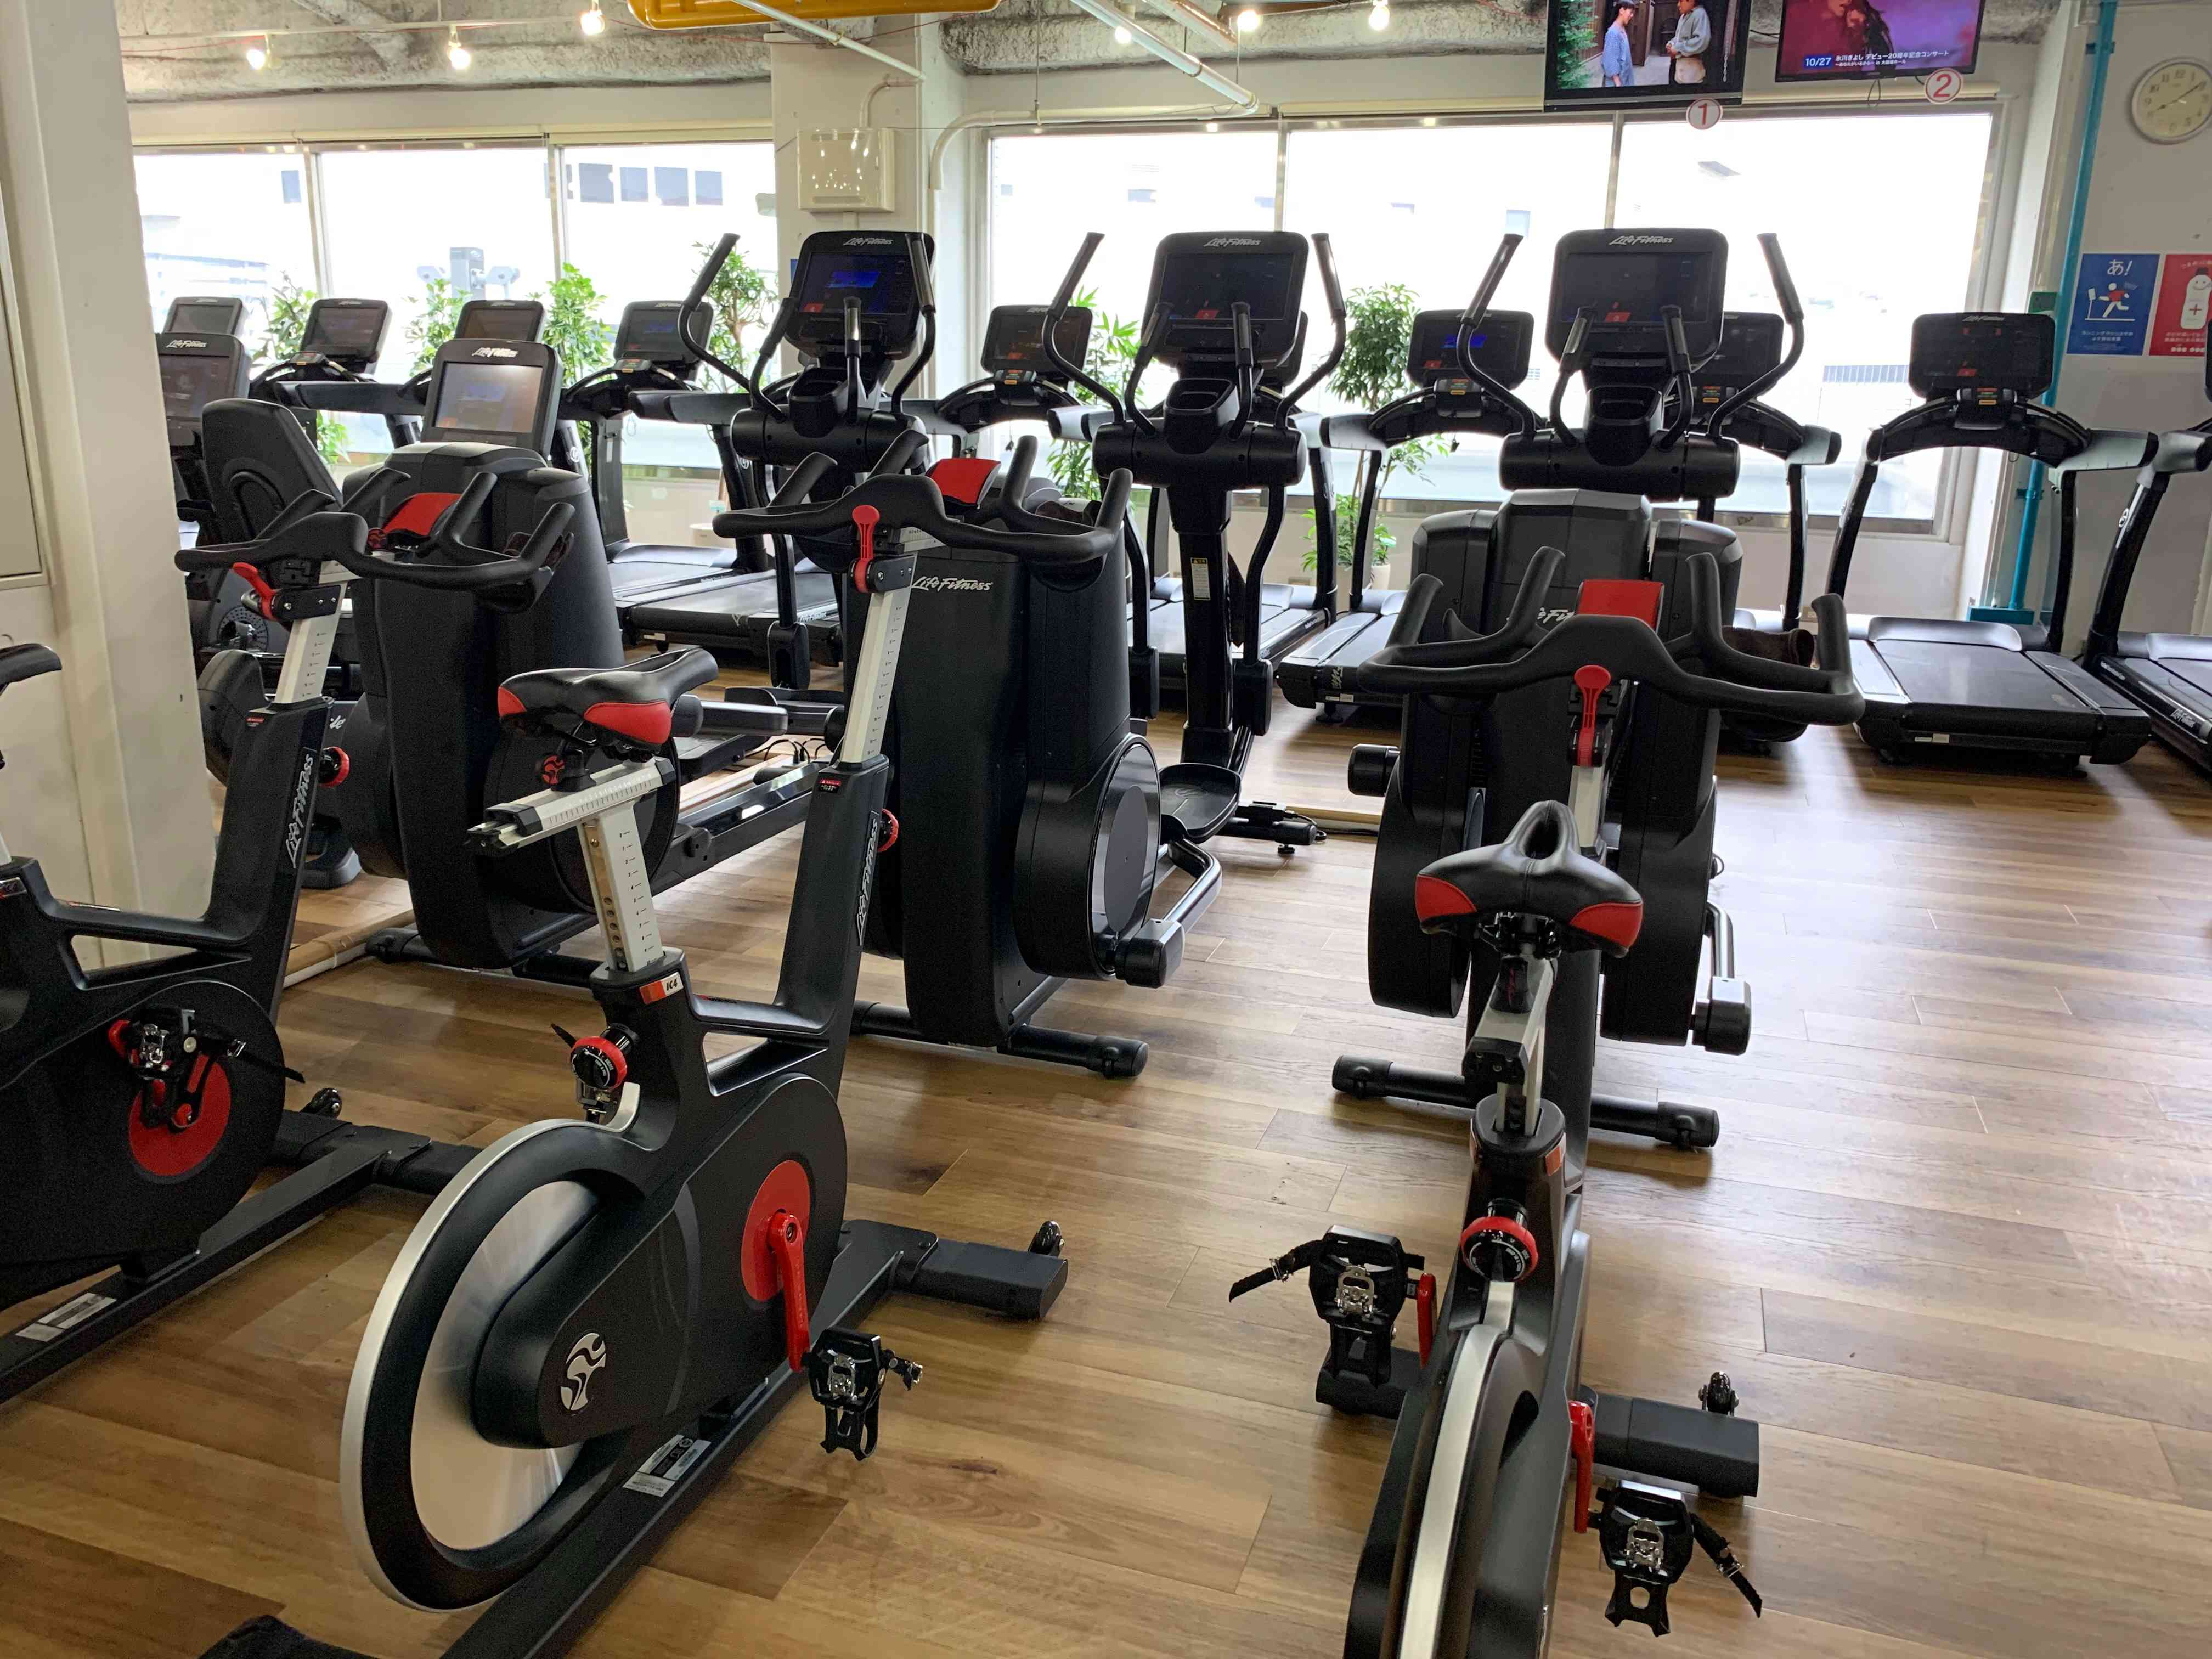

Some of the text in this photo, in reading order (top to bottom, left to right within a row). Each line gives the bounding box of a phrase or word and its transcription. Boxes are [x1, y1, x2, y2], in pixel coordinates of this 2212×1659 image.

[1805, 57, 1831, 66] 10/27
[1933, 74, 1952, 98] 2
[1699, 103, 1708, 125] 1
[666, 978, 678, 991] IC4
